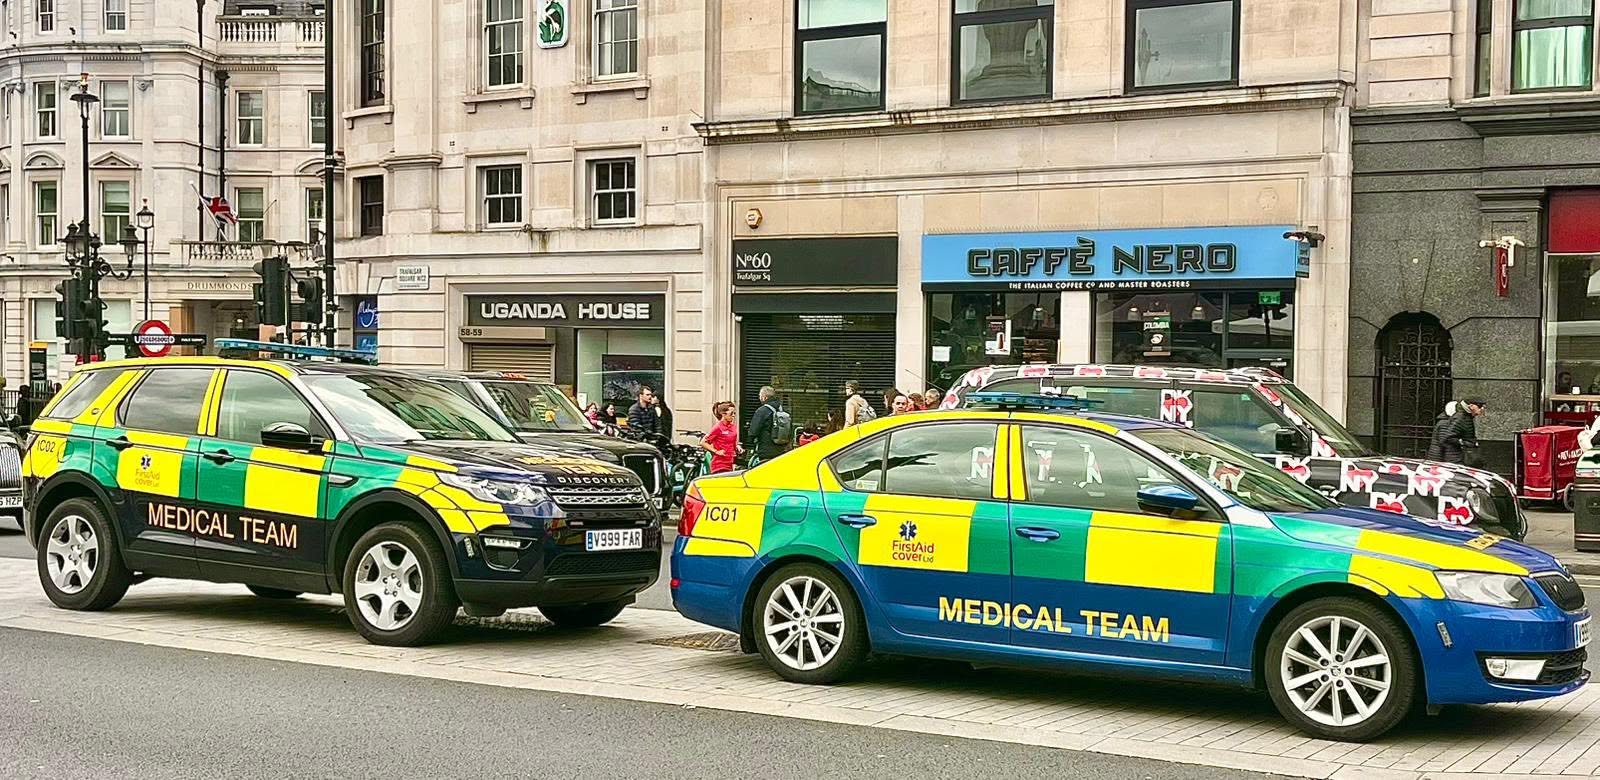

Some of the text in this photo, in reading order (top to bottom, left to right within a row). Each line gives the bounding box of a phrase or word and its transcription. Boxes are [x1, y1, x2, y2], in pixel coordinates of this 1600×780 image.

[968, 236, 1237, 276] CAFFÈ NERO
[736, 272, 771, 281] Trafalgar Sq
[187, 282, 254, 290] DRUMMONDS
[1118, 281, 1148, 289] MASTER
[481, 302, 650, 319] UGANDA HOUSE
[37, 439, 56, 453] IC02
[557, 476, 631, 484] DISCOVERY
[5, 496, 22, 505] HZP
[705, 506, 737, 521] IC01
[148, 502, 297, 549] MEDICAL TEAM
[594, 531, 640, 546] V999 FAR
[892, 540, 934, 554] FirstAid
[892, 551, 922, 562] cover
[939, 596, 1170, 643] MEDICAL TEAM
